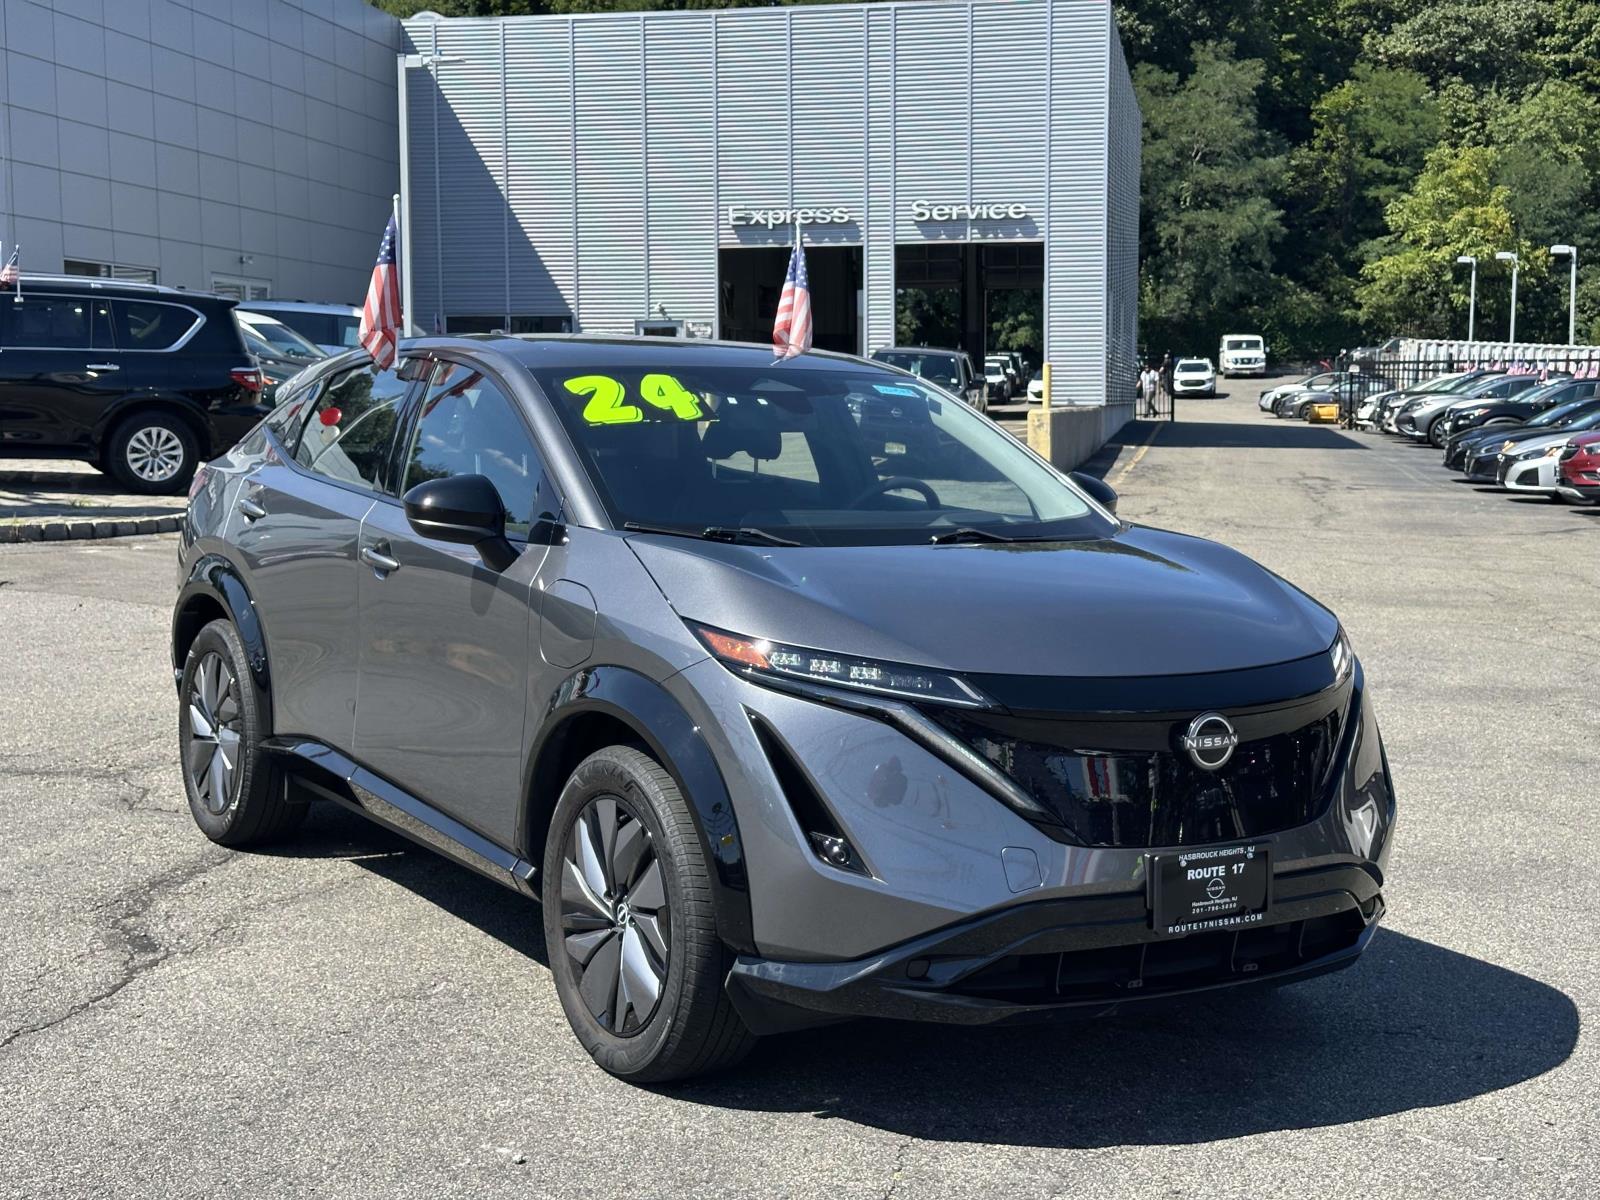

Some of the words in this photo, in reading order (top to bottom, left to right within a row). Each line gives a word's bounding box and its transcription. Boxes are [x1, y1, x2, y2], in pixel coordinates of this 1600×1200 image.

[728, 205, 850, 229] Express
[911, 199, 1027, 222] Service
[563, 373, 705, 425] 24
[1187, 734, 1238, 748] NISSAN
[1178, 851, 1218, 861] HASBROUCK
[1187, 865, 1226, 880] ROUTE
[1231, 863, 1245, 875] 17
[1168, 913, 1262, 934] ROUTE17NISSAN.COM
